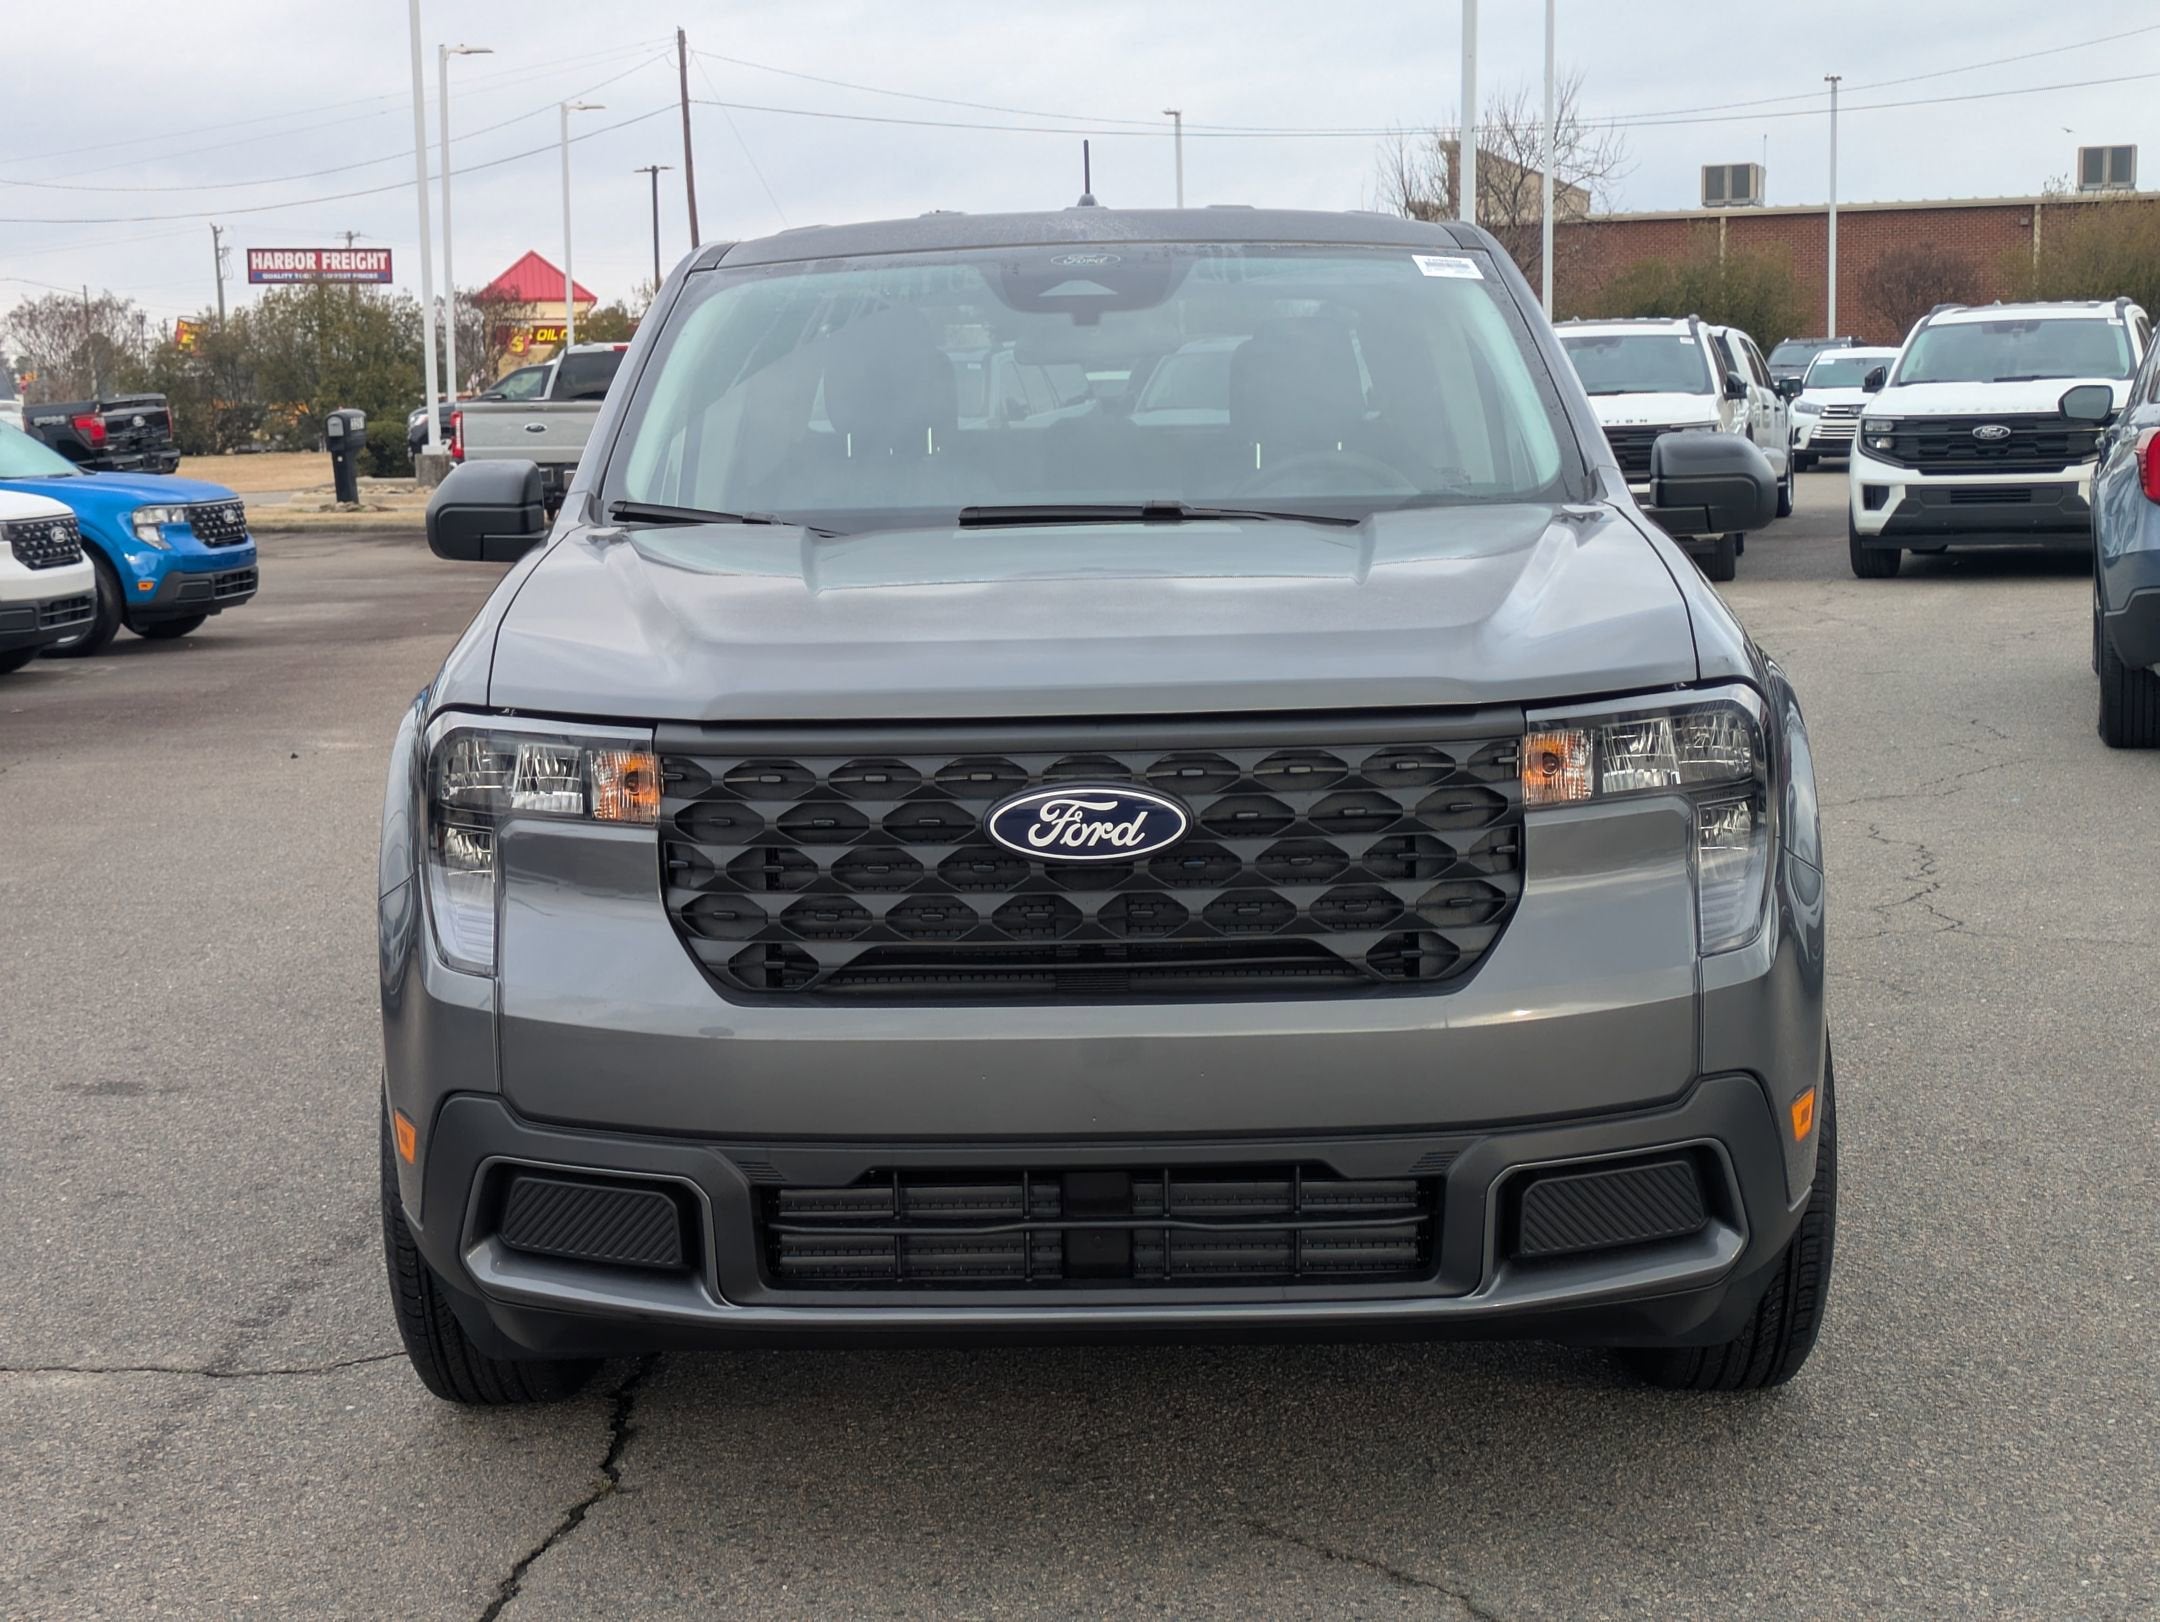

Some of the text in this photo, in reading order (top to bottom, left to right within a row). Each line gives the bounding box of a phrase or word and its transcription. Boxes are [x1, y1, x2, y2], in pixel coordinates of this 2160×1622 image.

[252, 252, 387, 270] HARBOR FREIGHT
[537, 328, 558, 341] OIL
[1028, 799, 1149, 847] Ford
